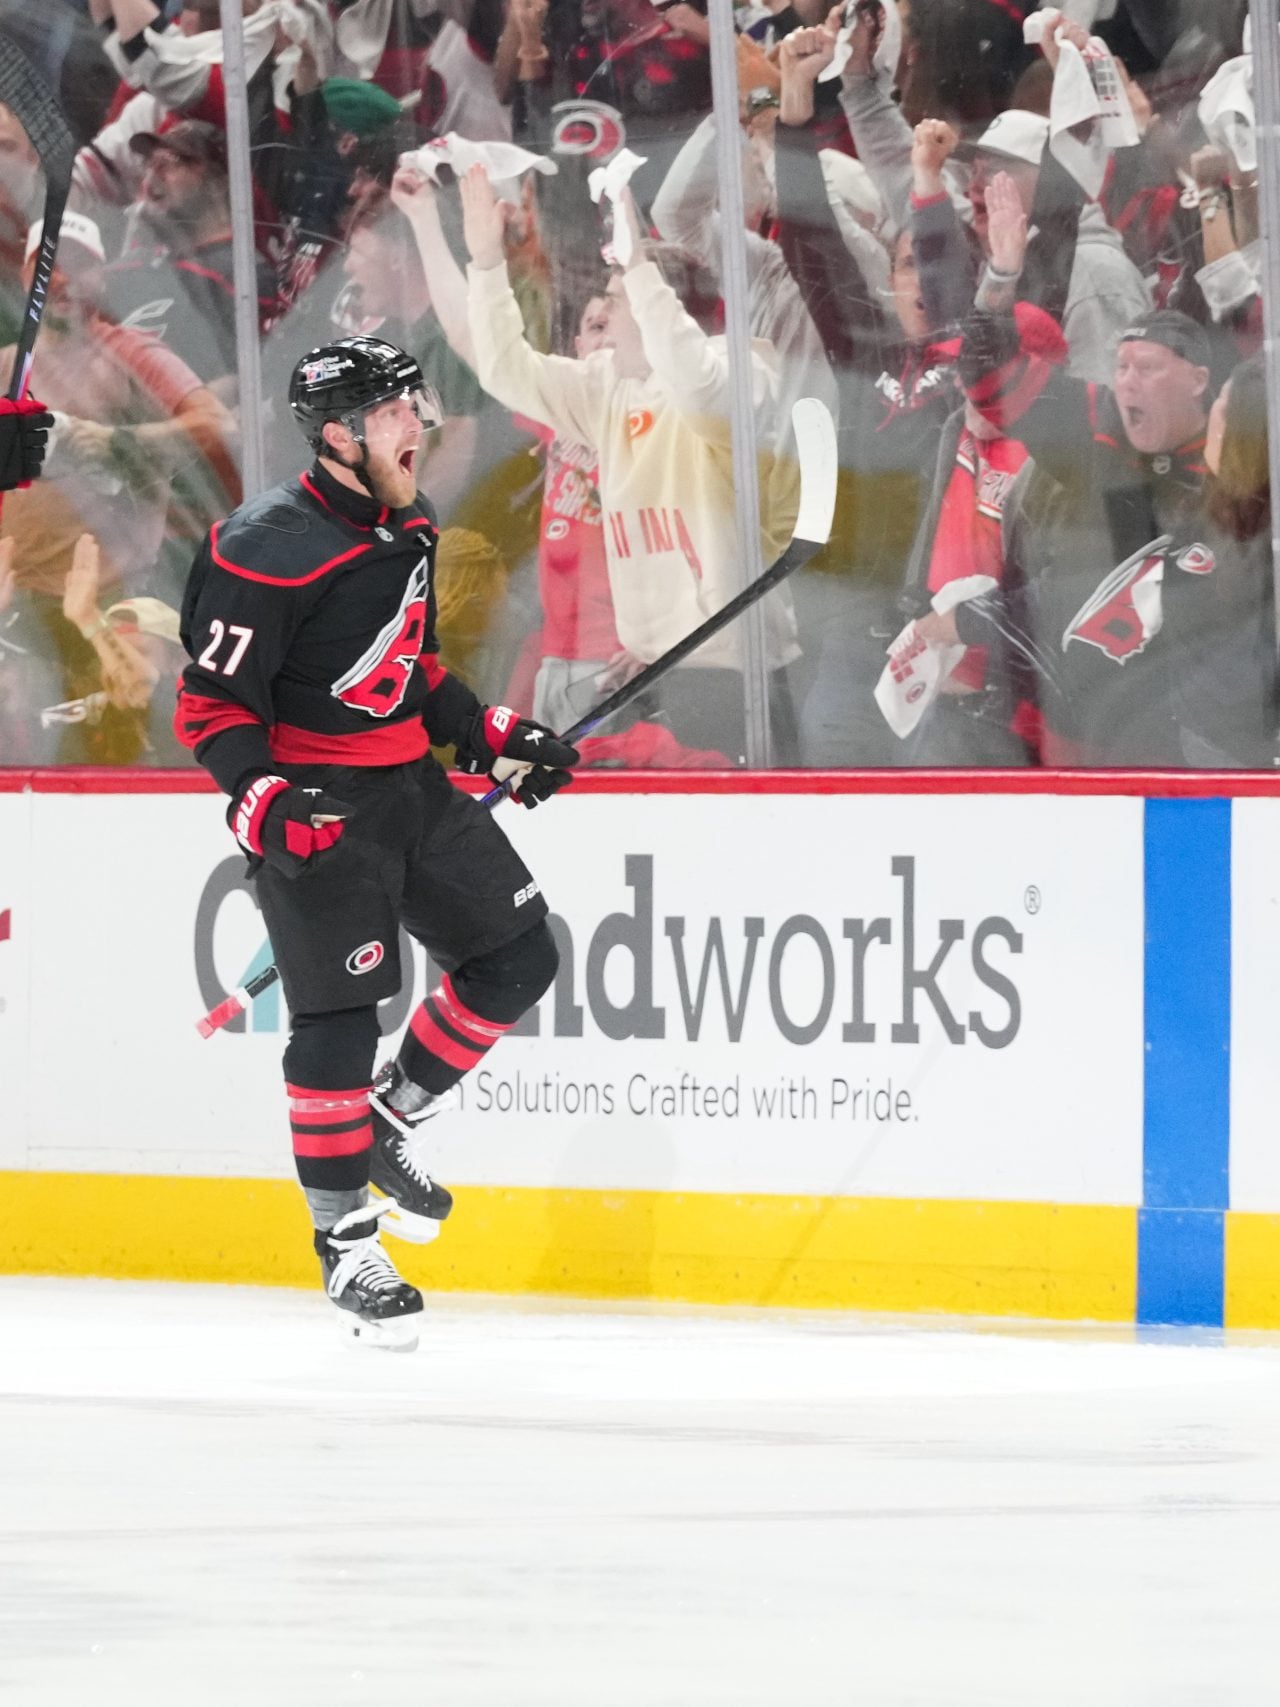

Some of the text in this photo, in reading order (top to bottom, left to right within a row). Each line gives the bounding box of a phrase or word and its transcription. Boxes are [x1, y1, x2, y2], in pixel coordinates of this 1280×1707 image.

[198, 619, 254, 676] 27
[475, 1069, 615, 1115] Solutions
[626, 1072, 740, 1119] Crafted
[753, 1076, 818, 1120] with
[830, 1077, 919, 1123] Pride.
